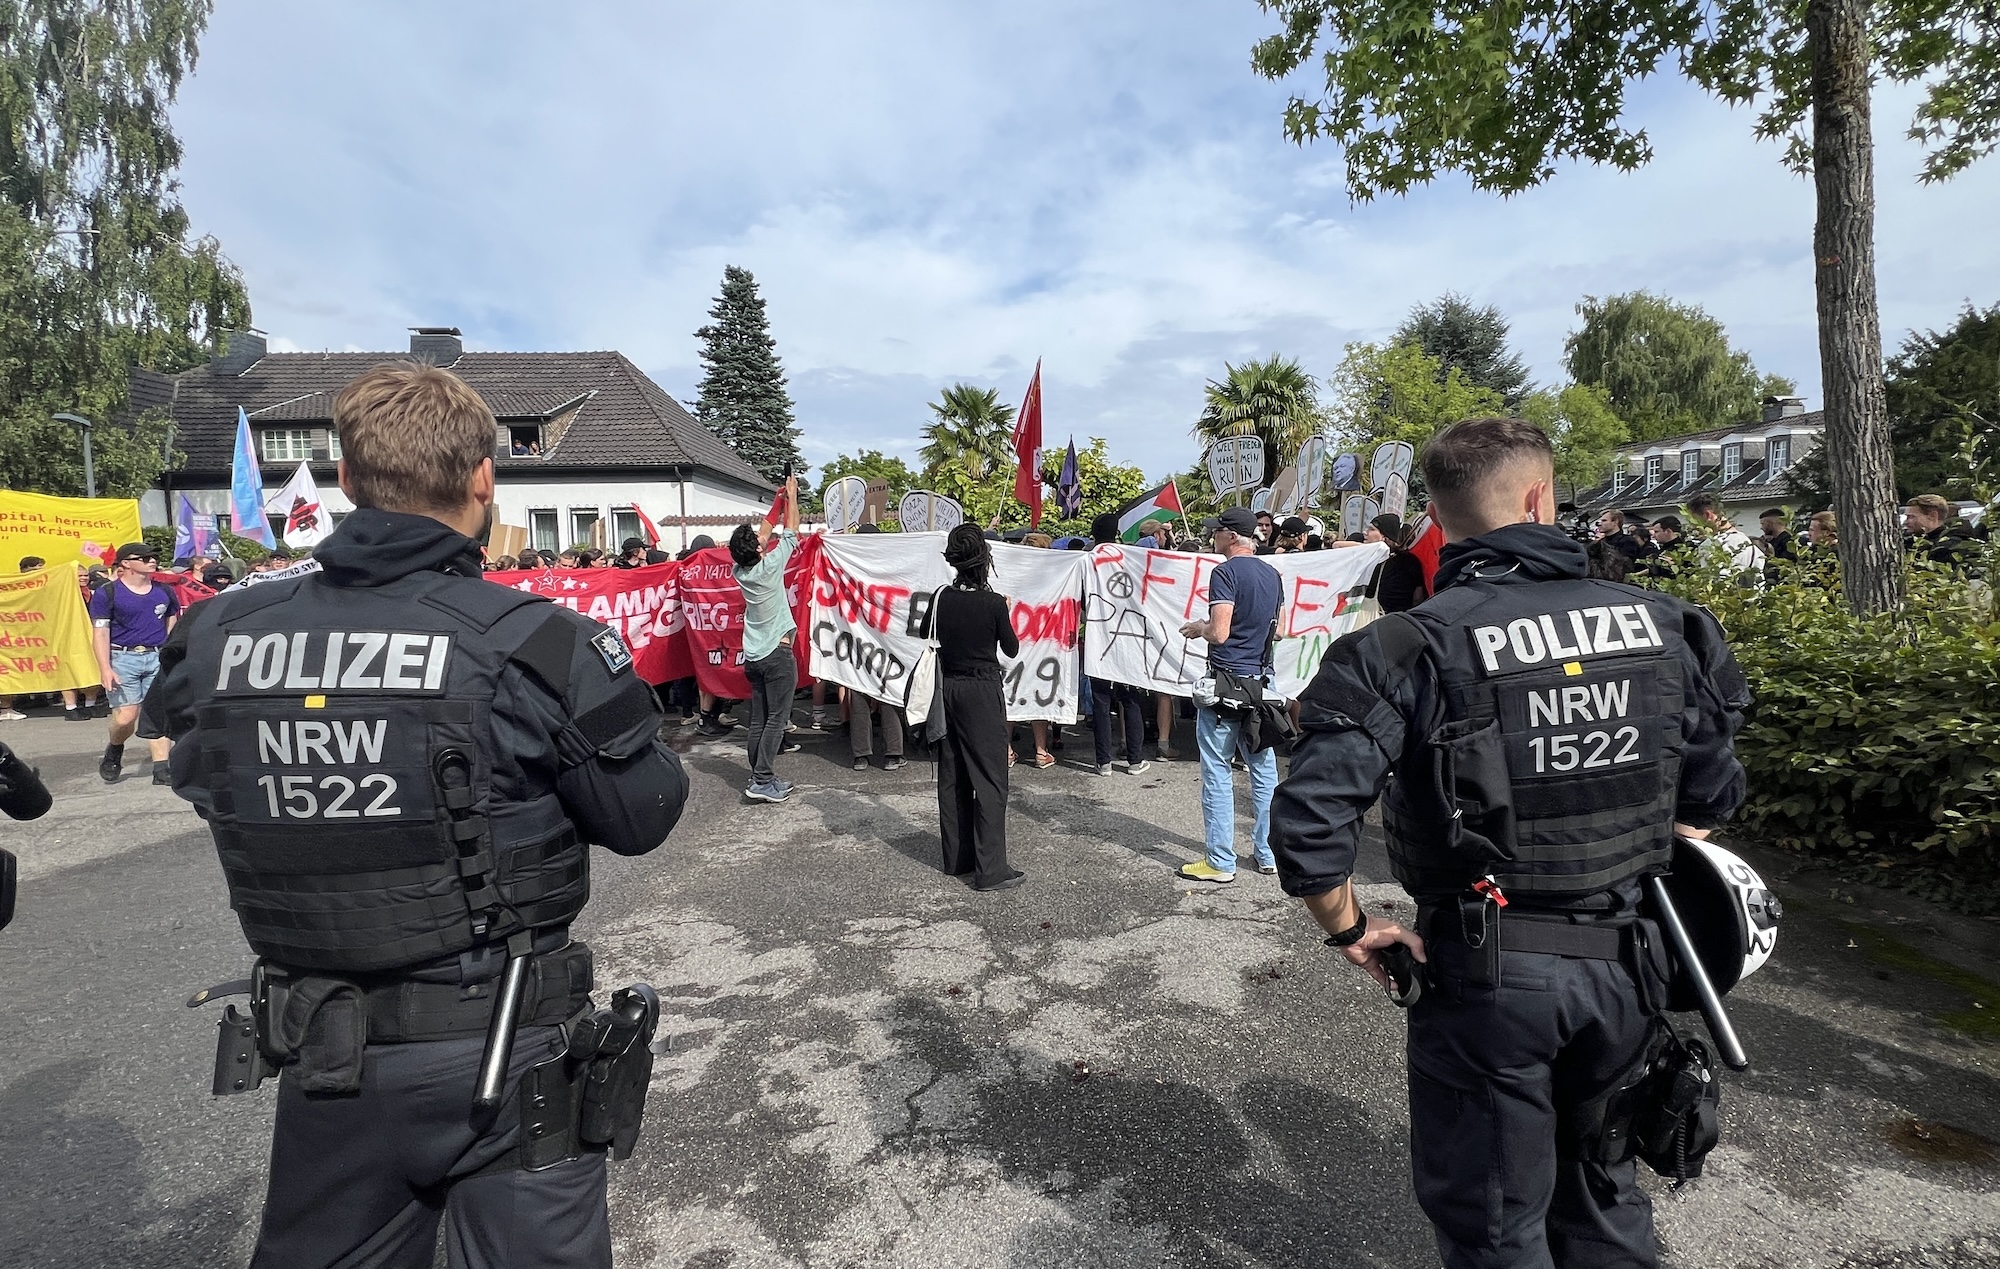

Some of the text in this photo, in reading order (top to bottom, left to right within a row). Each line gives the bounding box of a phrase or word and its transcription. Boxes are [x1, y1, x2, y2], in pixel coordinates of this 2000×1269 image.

[1240, 453, 1259, 463] MEIN
[39, 526, 81, 538] Krieg
[55, 515, 119, 530] herrscht,
[1474, 604, 1663, 671] POLIZEI
[216, 632, 449, 690] POLIZEI
[1528, 679, 1630, 728] NRW
[257, 720, 387, 764] NRW
[1528, 726, 1640, 773] 1522
[257, 773, 401, 819] 1522
